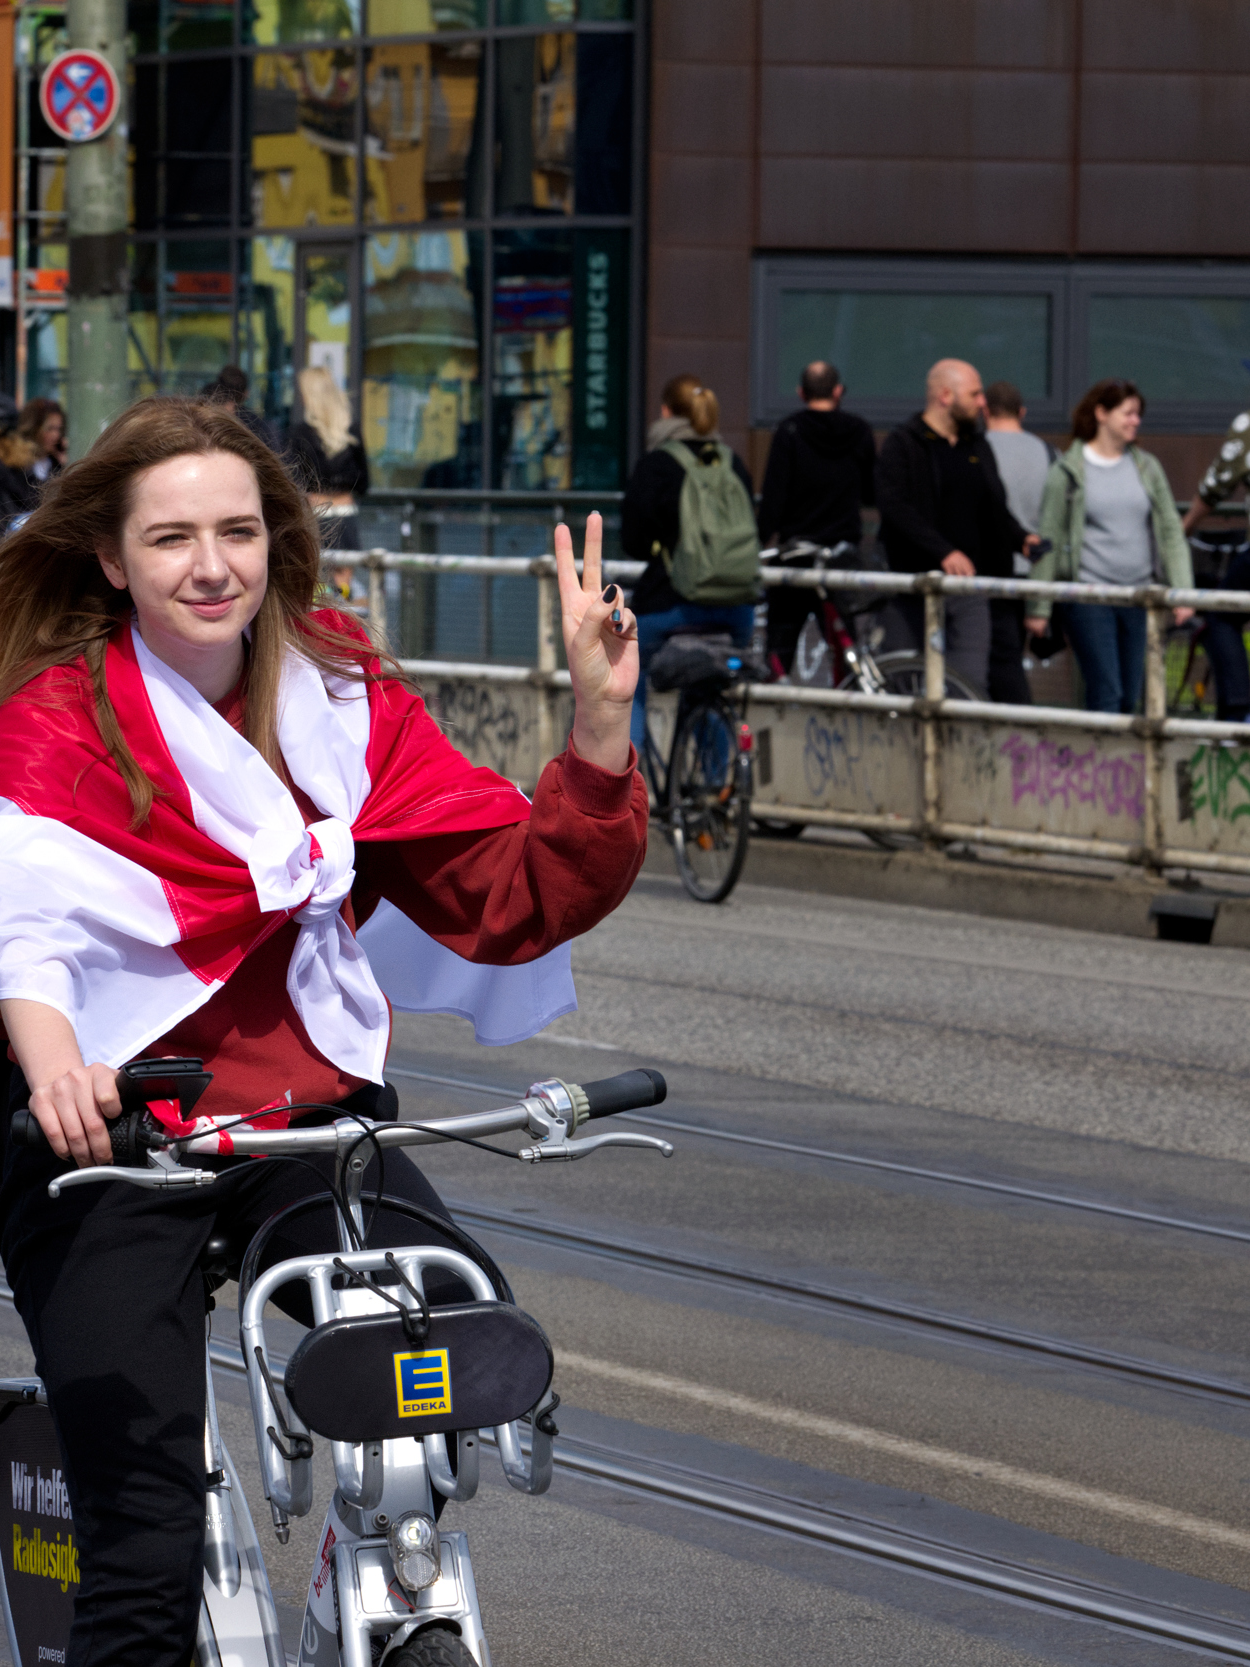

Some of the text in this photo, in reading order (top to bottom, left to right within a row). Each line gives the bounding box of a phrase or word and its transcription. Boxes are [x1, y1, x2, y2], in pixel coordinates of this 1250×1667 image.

[586, 252, 609, 430] STARBUCKS
[403, 1401, 447, 1412] EDEKA
[11, 1461, 35, 1513] Wir
[13, 1523, 81, 1593] Radlosigk
[38, 1645, 66, 1665] powered
